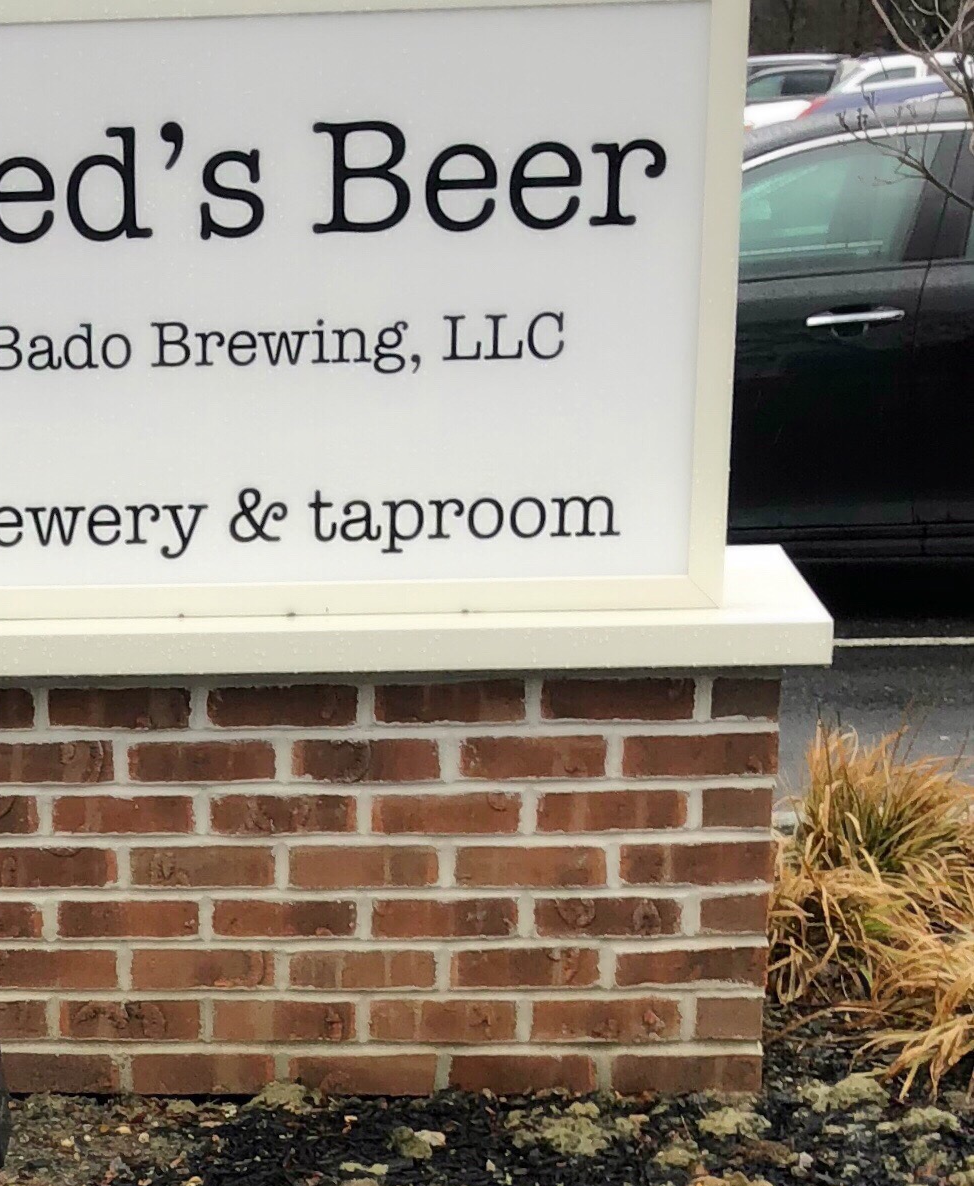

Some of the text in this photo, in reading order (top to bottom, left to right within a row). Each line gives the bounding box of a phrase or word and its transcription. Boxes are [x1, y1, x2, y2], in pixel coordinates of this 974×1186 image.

[311, 119, 668, 235] Beer
[150, 318, 422, 374] Brewing,
[441, 311, 566, 361] LLC
[229, 487, 288, 543] &
[308, 489, 621, 554] taproom
